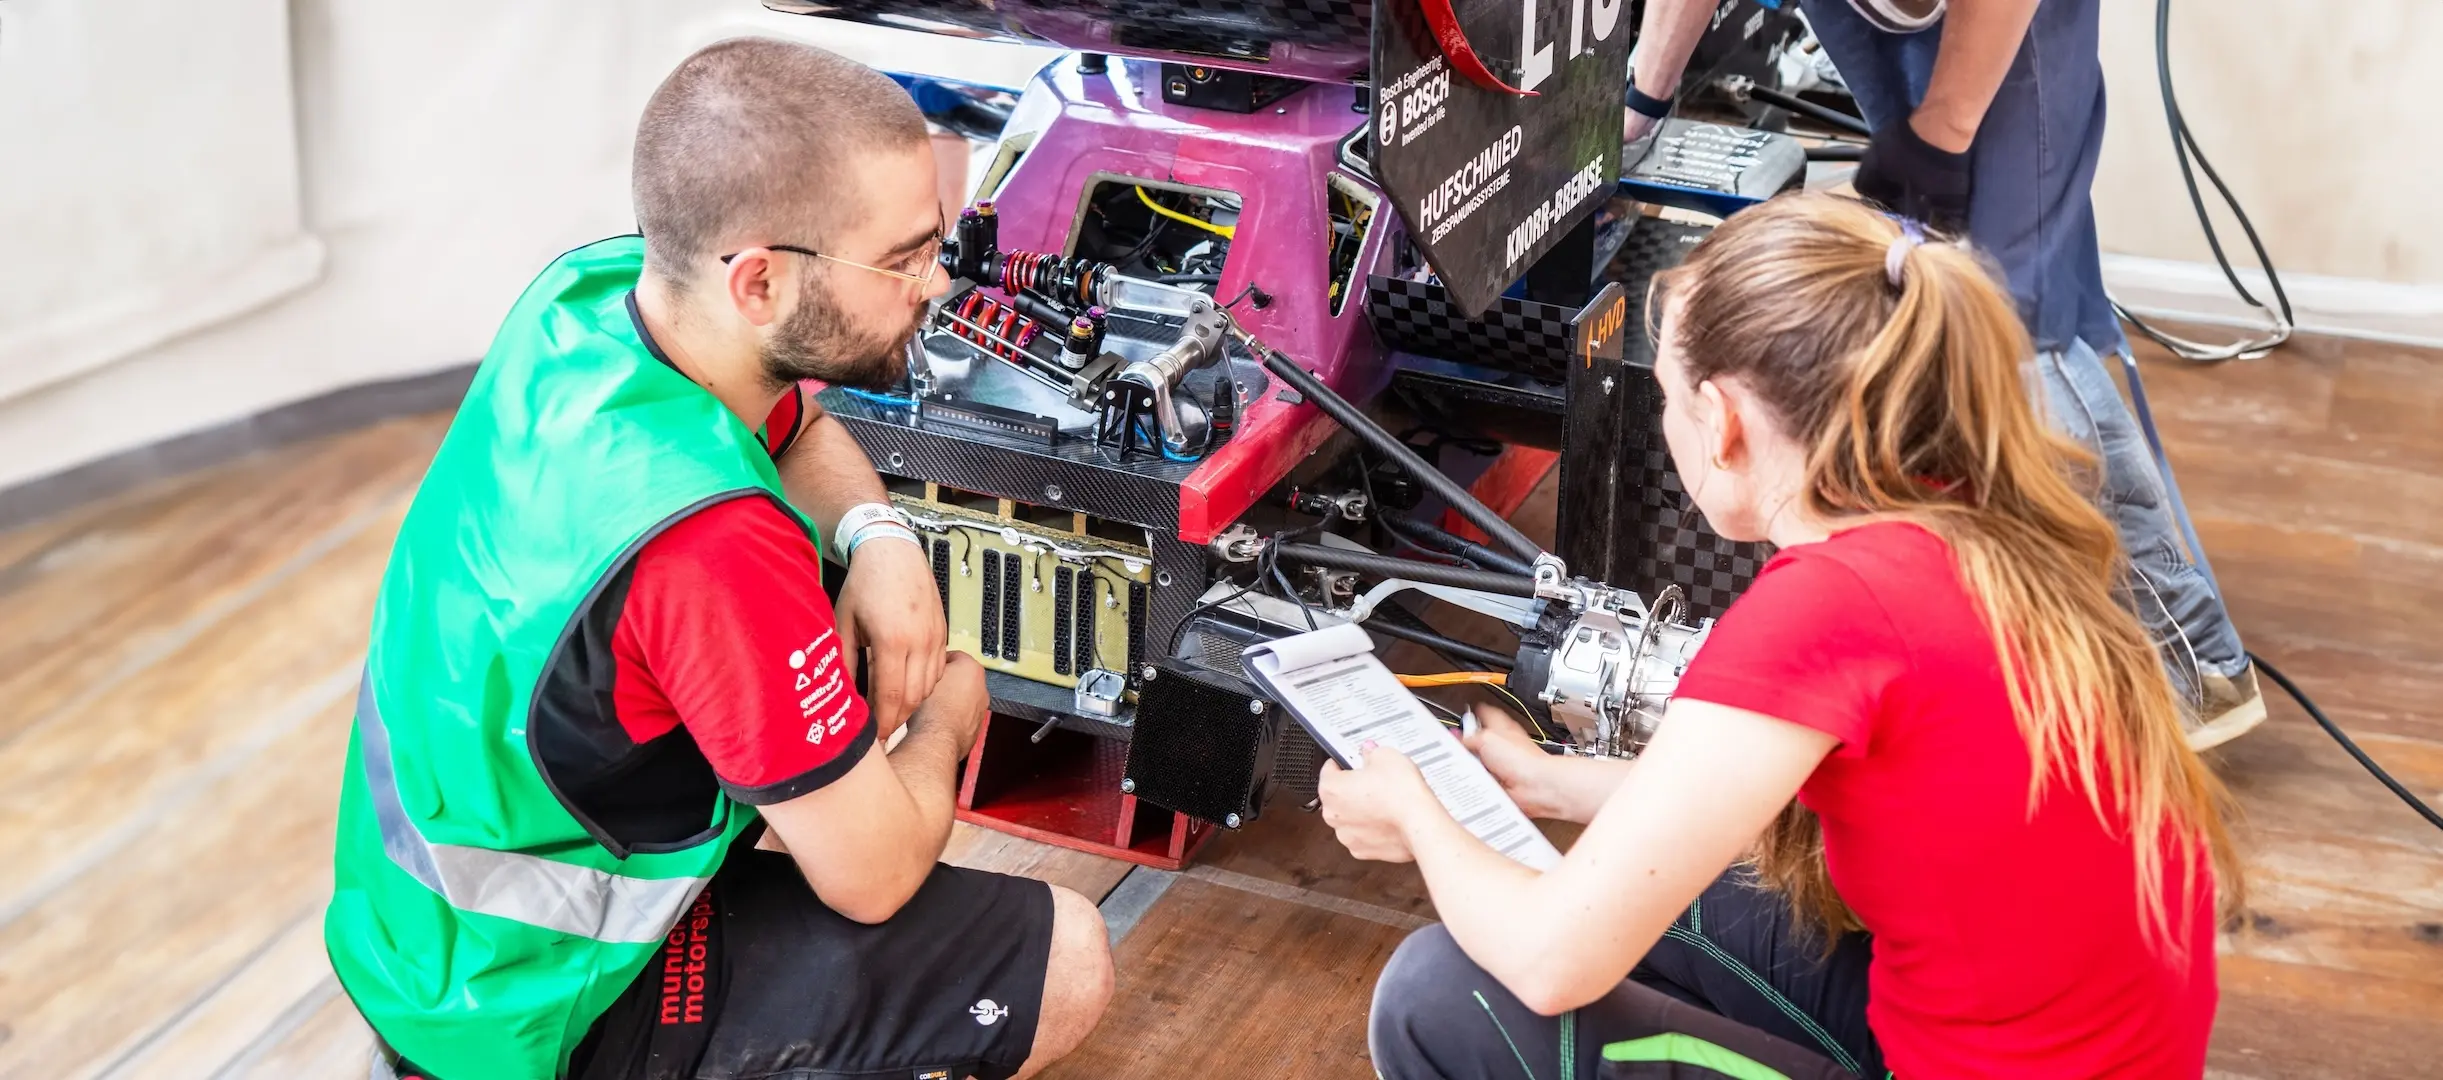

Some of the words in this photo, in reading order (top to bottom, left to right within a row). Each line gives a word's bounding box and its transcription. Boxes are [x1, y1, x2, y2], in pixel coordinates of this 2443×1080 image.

[1380, 77, 1402, 105] Bosch
[1403, 54, 1442, 89] Engineering
[1402, 68, 1450, 128] BOSCH
[1402, 117, 1428, 147] Invented
[1427, 113, 1437, 128] for
[1420, 125, 1522, 233] HUFSCHMIED
[1431, 168, 1511, 246] ZERSPANUNGSSYSTEME
[1506, 153, 1604, 269] KNORR-BREMSE
[1598, 295, 1626, 344] HVD
[813, 645, 838, 680] ALTAIR
[683, 887, 716, 1024] motorspo
